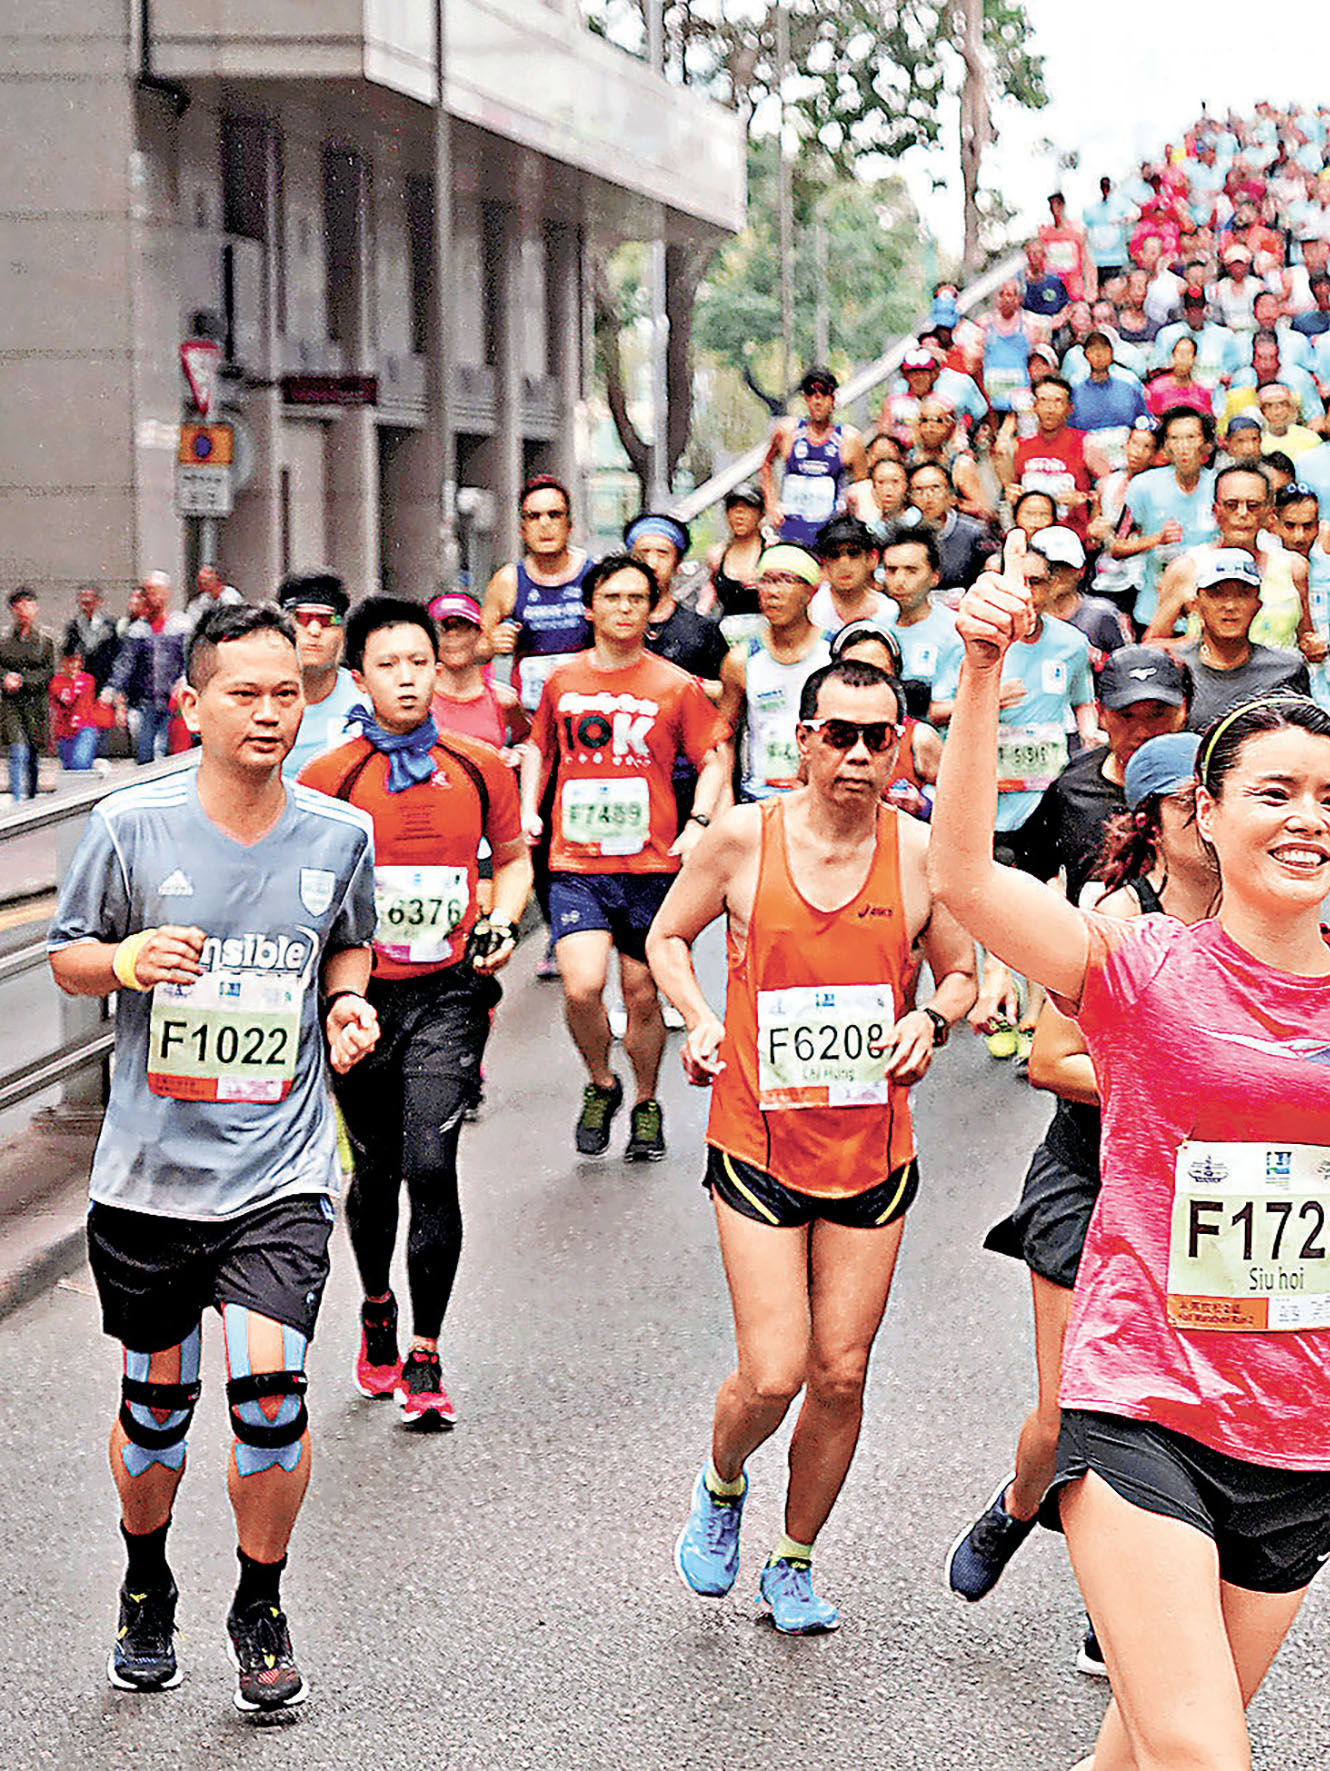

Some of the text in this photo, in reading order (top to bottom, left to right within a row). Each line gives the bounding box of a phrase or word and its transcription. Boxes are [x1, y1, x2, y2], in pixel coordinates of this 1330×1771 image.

[159, 1020, 288, 1065] F1022
[769, 1023, 885, 1064] F6208
[1249, 1266, 1305, 1291] Siu hoi
